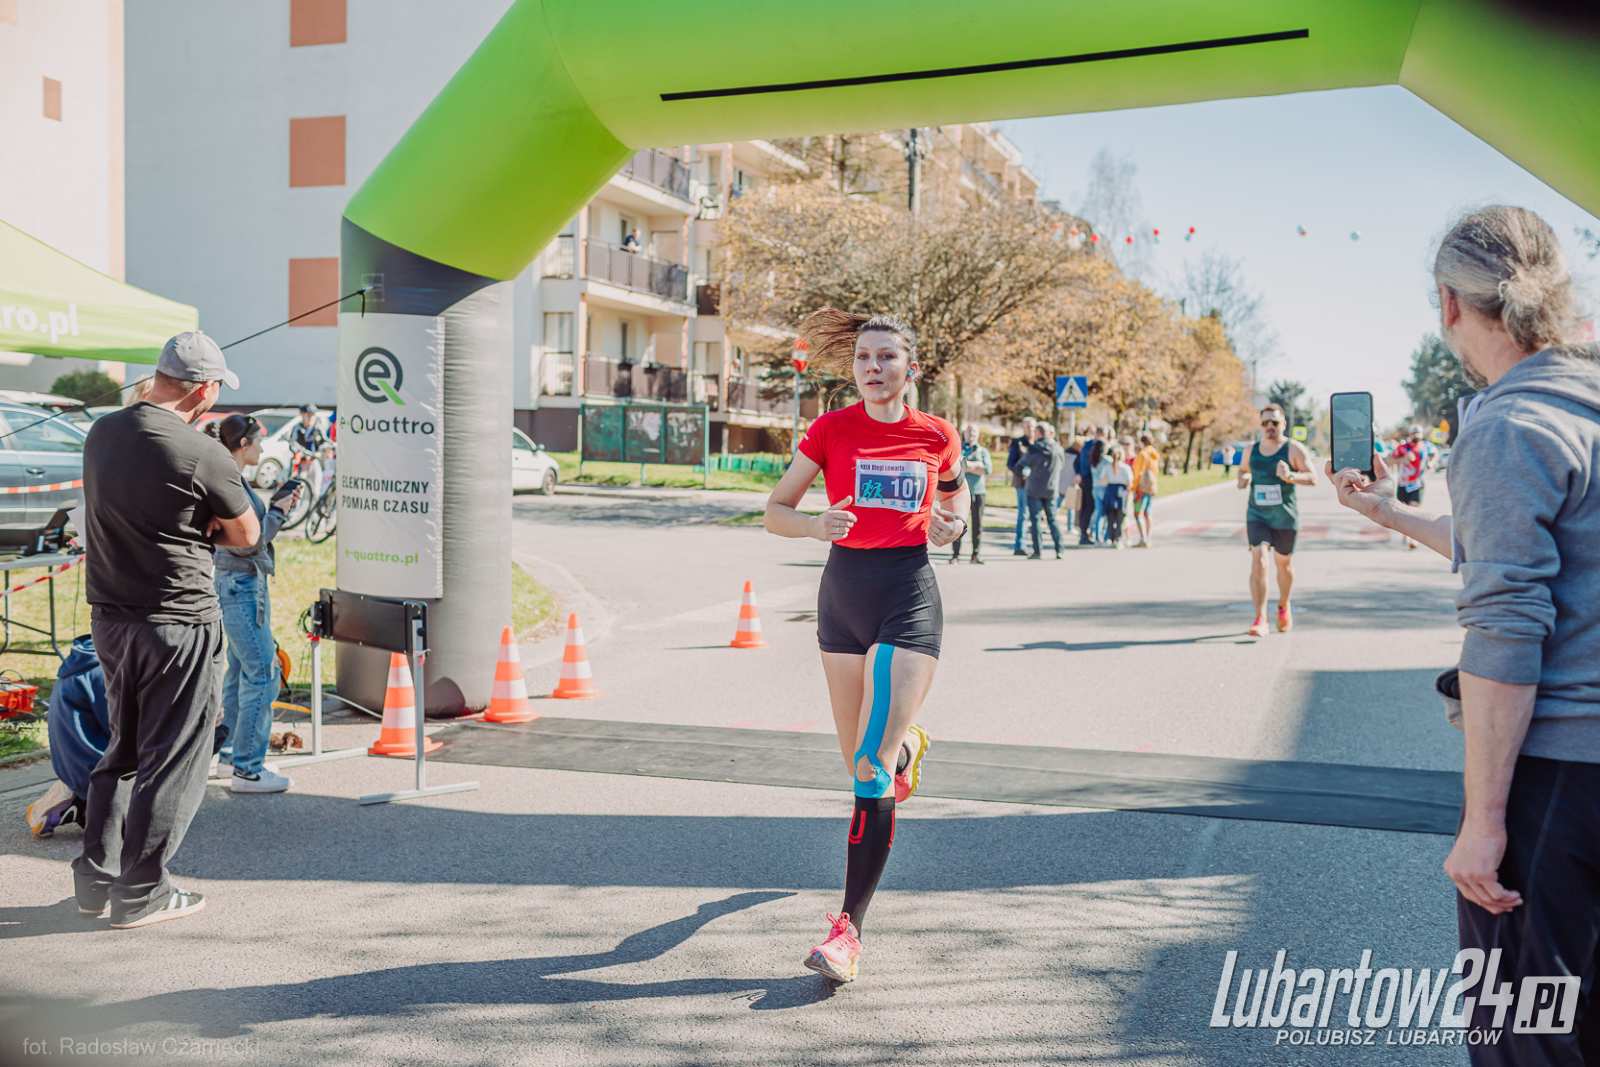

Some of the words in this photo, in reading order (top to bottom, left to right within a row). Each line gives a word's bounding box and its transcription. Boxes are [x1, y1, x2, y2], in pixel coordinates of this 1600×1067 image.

[0, 303, 79, 344] ro.pl
[342, 475, 429, 494] ELEKTRONICZNY
[891, 478, 921, 499] 101
[342, 495, 379, 511] POMIAR
[383, 499, 429, 514] CZASU
